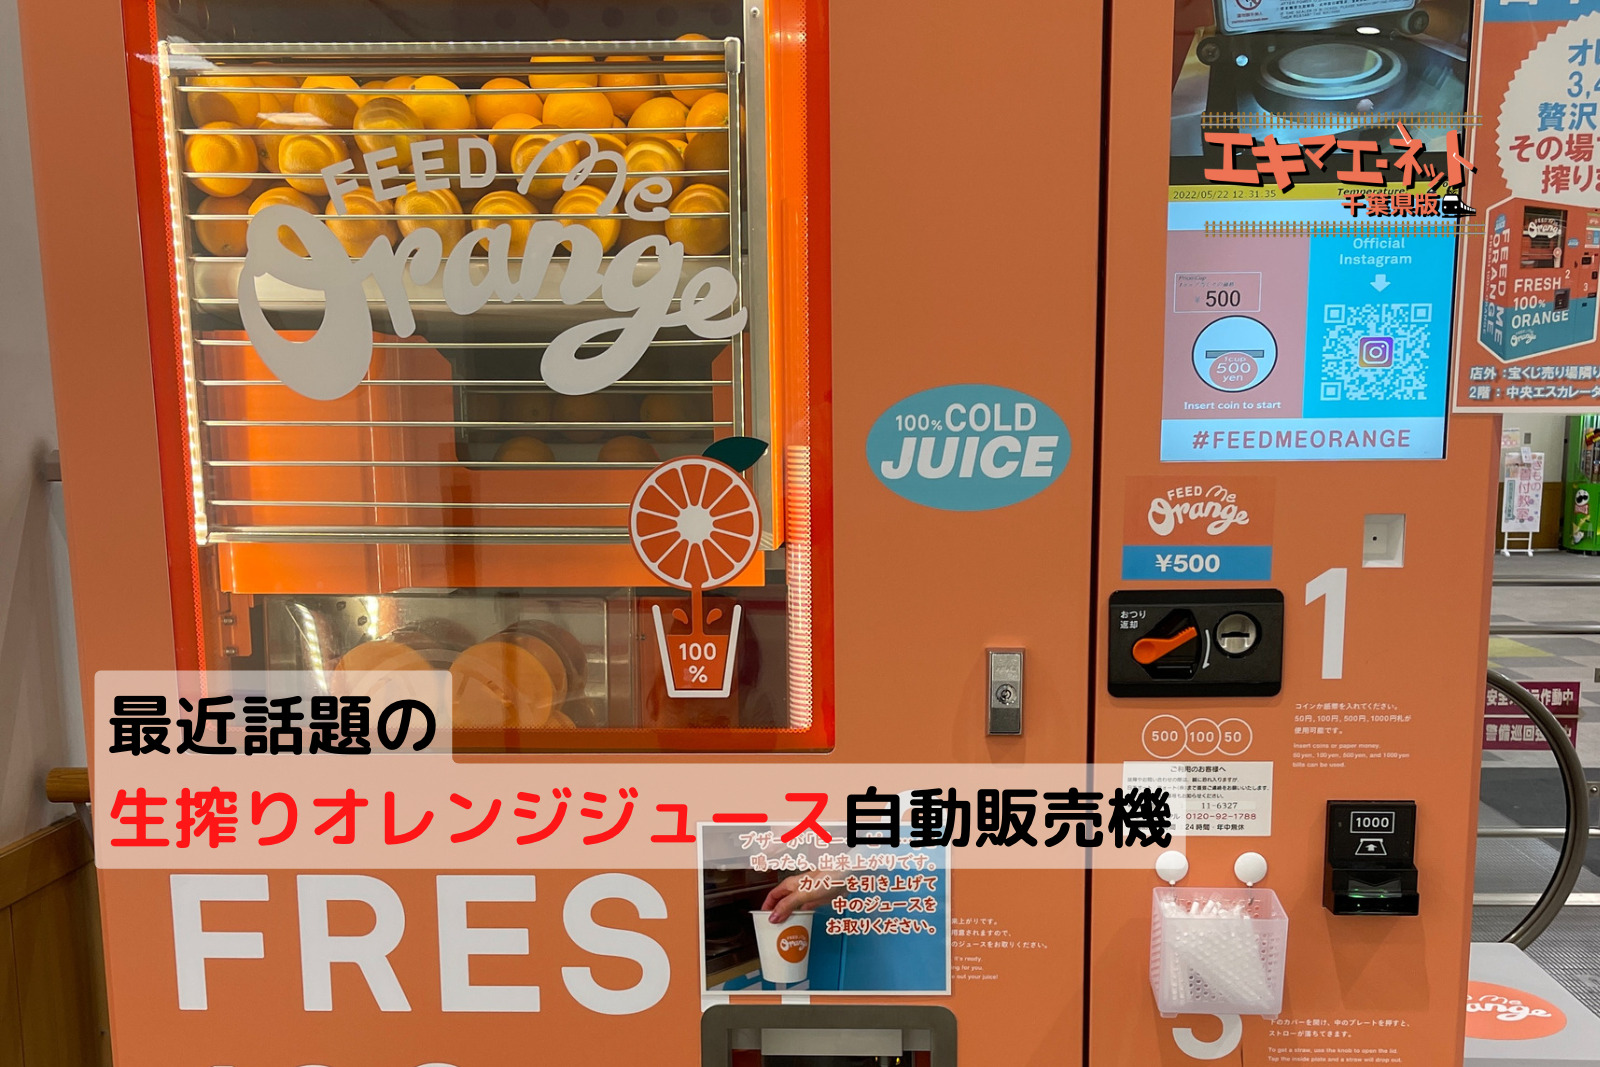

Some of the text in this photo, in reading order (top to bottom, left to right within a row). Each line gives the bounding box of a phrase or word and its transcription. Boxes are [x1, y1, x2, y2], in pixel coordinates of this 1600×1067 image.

[1509, 133, 1600, 162] その場
[320, 136, 498, 216] FEED
[1173, 190, 1229, 200] 2022/05/22
[1353, 237, 1406, 249] Official
[1339, 252, 1413, 268] Instagram
[1513, 276, 1562, 293] FRESH
[238, 203, 749, 401] Orange
[1205, 290, 1241, 307] 500
[1511, 309, 1570, 329] ORANGE
[1216, 362, 1251, 374] 500
[1222, 374, 1243, 382] yen
[1184, 400, 1282, 410] Insert coin to start
[945, 402, 1037, 432] COLD
[1192, 429, 1411, 449] #FEEDMEORANGE
[881, 435, 1059, 480] JUICE
[1167, 485, 1203, 500] FEED
[1148, 497, 1250, 536] Orange
[1155, 553, 1221, 573] ¥500
[1119, 609, 1147, 619] おつり
[1119, 620, 1139, 630] 返却
[1305, 568, 1348, 680] 1
[678, 642, 717, 661] 100
[1151, 730, 1179, 742] 500
[1189, 731, 1215, 743] 100
[1224, 731, 1242, 743] 50
[1201, 801, 1238, 810] 11-6327
[1185, 812, 1257, 820] 0120-92-1788
[1355, 817, 1390, 828] 1000
[751, 853, 937, 872] 鳴ったら、出来上がりです。
[799, 875, 938, 892] カバーを引き上げて
[832, 896, 937, 914] 中のジュースを
[825, 916, 937, 934] お取りください。
